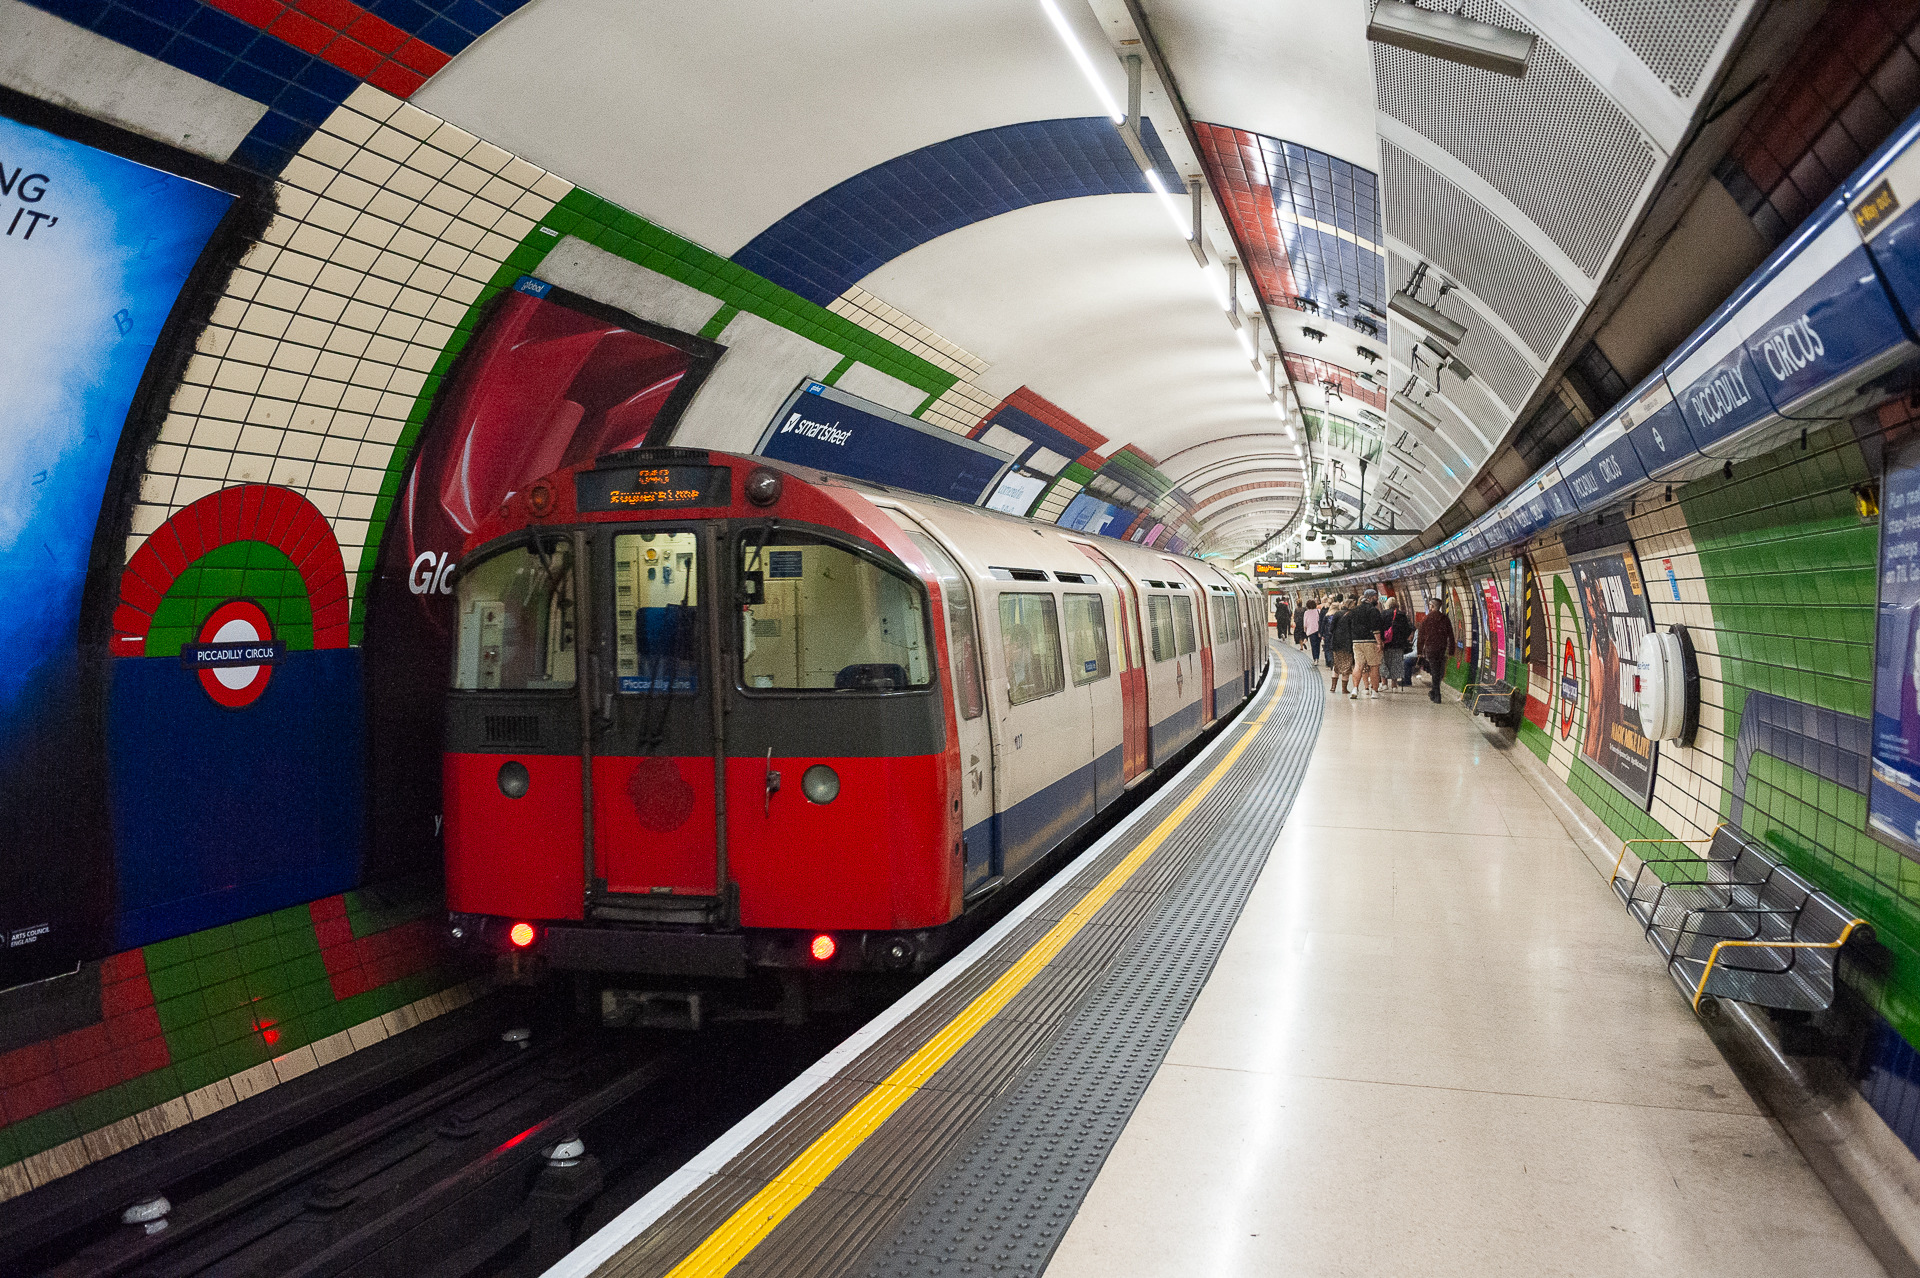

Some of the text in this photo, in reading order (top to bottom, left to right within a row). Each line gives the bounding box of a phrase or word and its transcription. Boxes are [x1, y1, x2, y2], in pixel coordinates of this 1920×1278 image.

[520, 280, 545, 293] global
[1691, 314, 1825, 427] PICCADILLY CIRCUS
[794, 419, 853, 446] smartsheet
[1598, 454, 1623, 484] CIRCUS
[197, 648, 274, 661] PICCADILLY CIRCUS
[11, 932, 26, 941] ARTS
[26, 926, 50, 938] COUNCIL
[10, 936, 38, 948] ENGLAND
